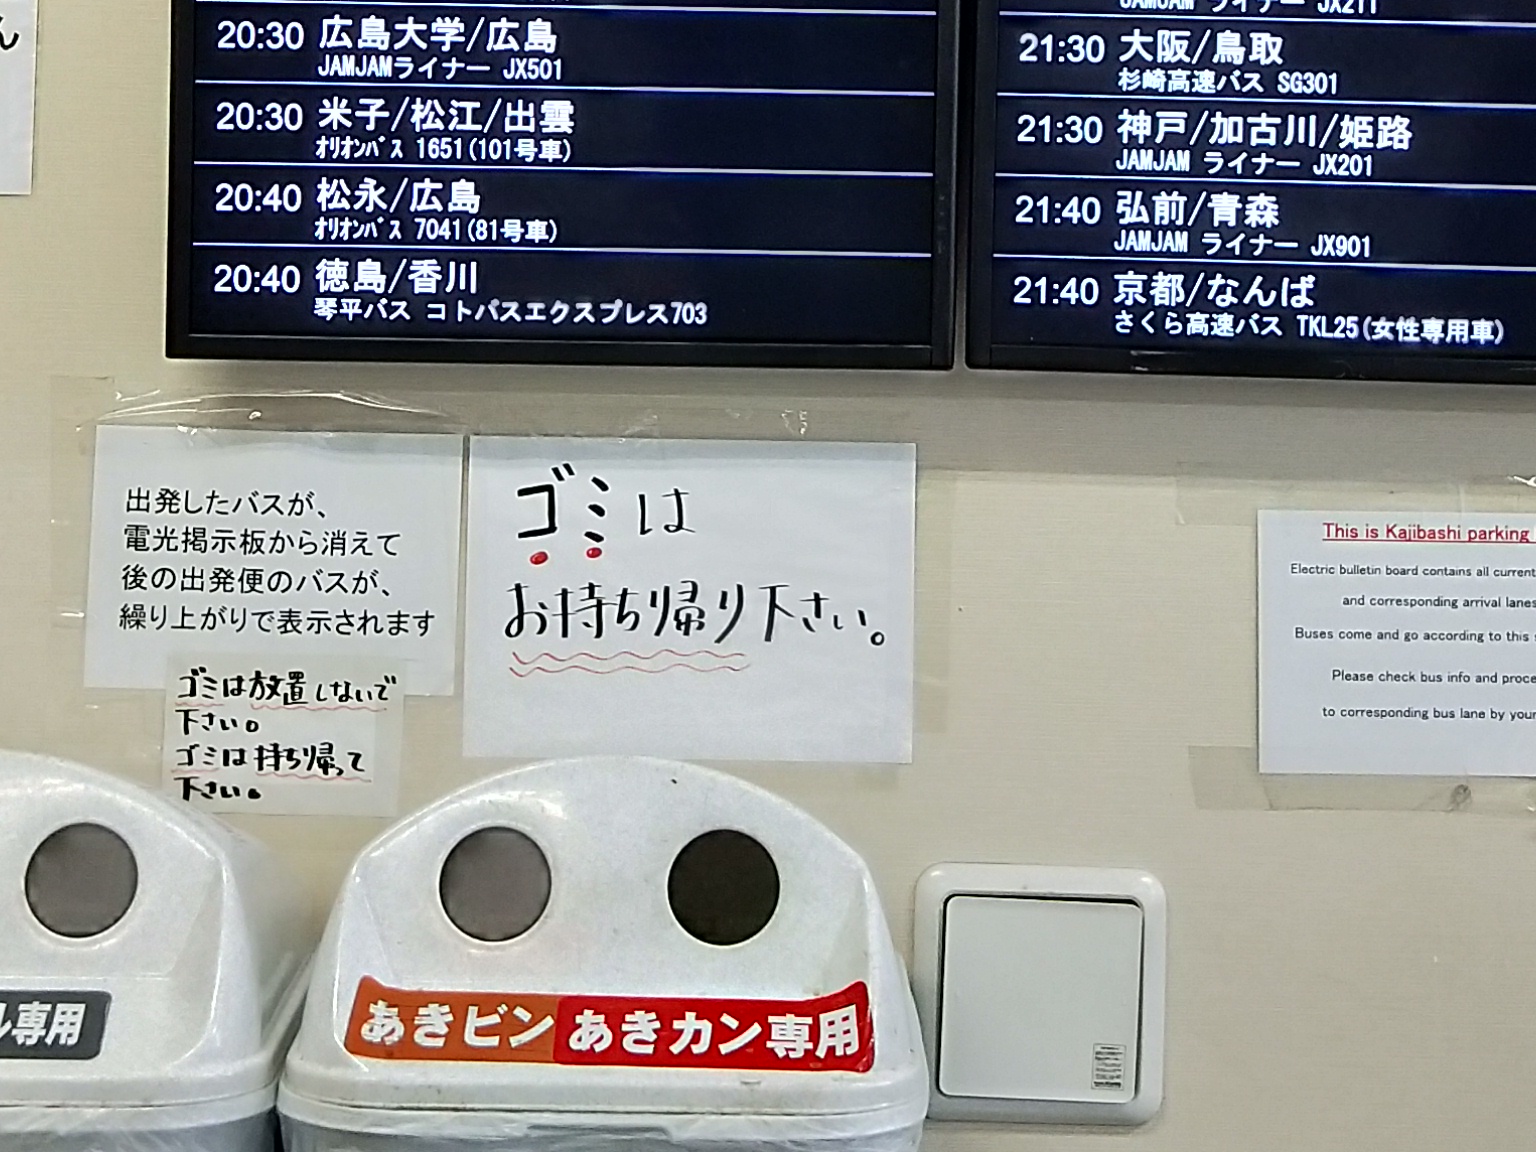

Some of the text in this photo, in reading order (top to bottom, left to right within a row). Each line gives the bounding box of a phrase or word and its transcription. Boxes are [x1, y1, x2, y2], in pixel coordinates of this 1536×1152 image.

[218, 16, 557, 53] 20:30 広島大学/広島
[318, 56, 562, 80] JAMJAMライナー JX501
[1015, 190, 1280, 229] 21:40 弘前/青森
[126, 487, 327, 518] 出発したバスが、
[517, 463, 696, 544] ゴミは
[124, 525, 401, 557] 電光掲示板から消えて
[1323, 523, 1358, 539] This
[1366, 524, 1378, 539] is
[1386, 524, 1461, 541] Kajibashi
[1467, 526, 1529, 543] parking
[121, 564, 390, 596] 後の出発便のバスが、
[1291, 563, 1335, 575] Electric
[1340, 564, 1381, 575] bulletin
[1386, 565, 1418, 576] board
[1423, 566, 1471, 577] contains
[1476, 566, 1489, 577] all
[1493, 567, 1536, 578] current
[119, 602, 436, 638] 繰り上がりで表示されます
[504, 580, 885, 646] お持ち帰り下さい。
[1295, 628, 1333, 640] Buses
[1339, 630, 1372, 640] come
[1377, 629, 1399, 640] and
[1404, 631, 1418, 644] go
[1423, 630, 1484, 645] according
[1489, 631, 1501, 642] to
[1506, 630, 1529, 642] this
[176, 667, 398, 705] ゴミは放置しないで
[1332, 670, 1373, 682] Please
[1379, 671, 1416, 683] check
[1420, 671, 1443, 683] bus
[1448, 671, 1470, 683] info
[1475, 671, 1497, 684] and
[175, 709, 259, 735] 下さい。
[175, 742, 365, 776] ゴミは持ち帰って
[173, 777, 262, 802] 下さい。
[360, 999, 860, 1059] あきビン あきカン専用
